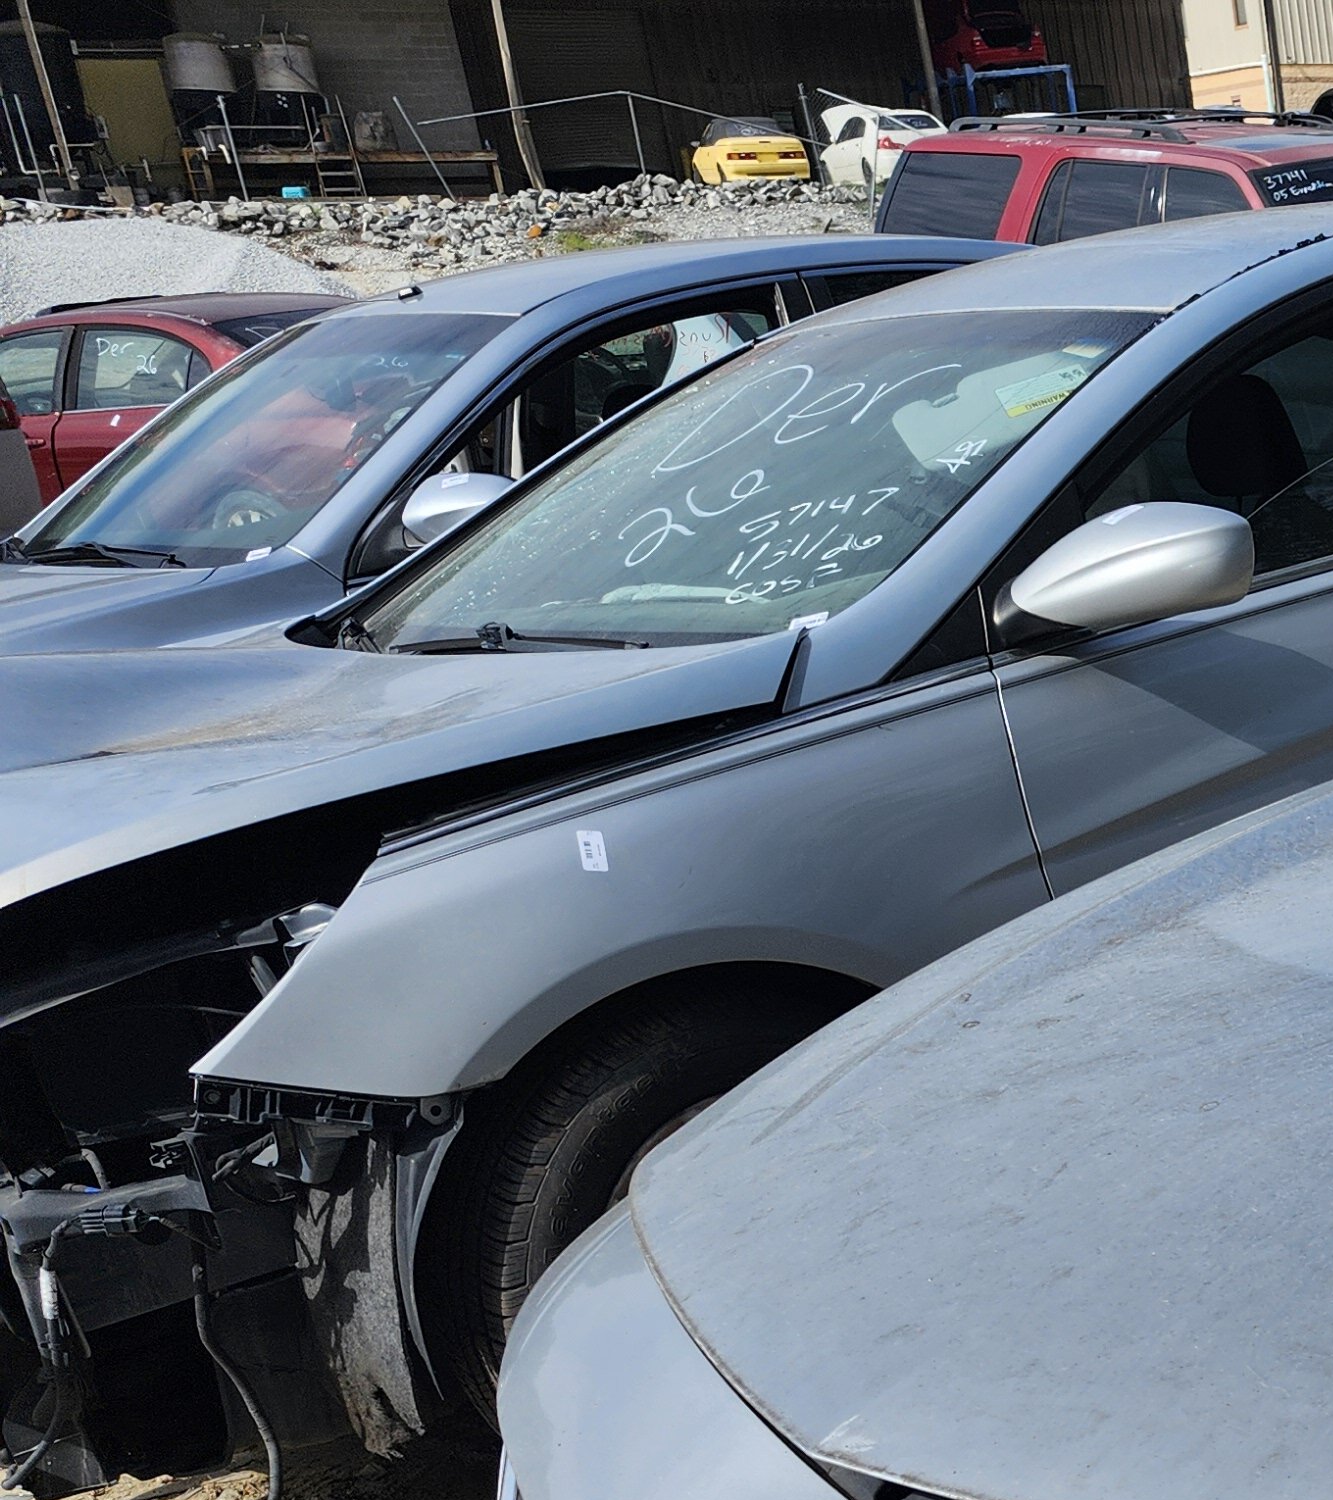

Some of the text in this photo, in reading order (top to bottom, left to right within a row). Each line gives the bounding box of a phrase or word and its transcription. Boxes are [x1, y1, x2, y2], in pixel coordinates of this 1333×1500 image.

[1263, 169, 1308, 190] 37741
[95, 337, 135, 357] Der
[135, 354, 158, 374] 26
[650, 364, 962, 476] Der
